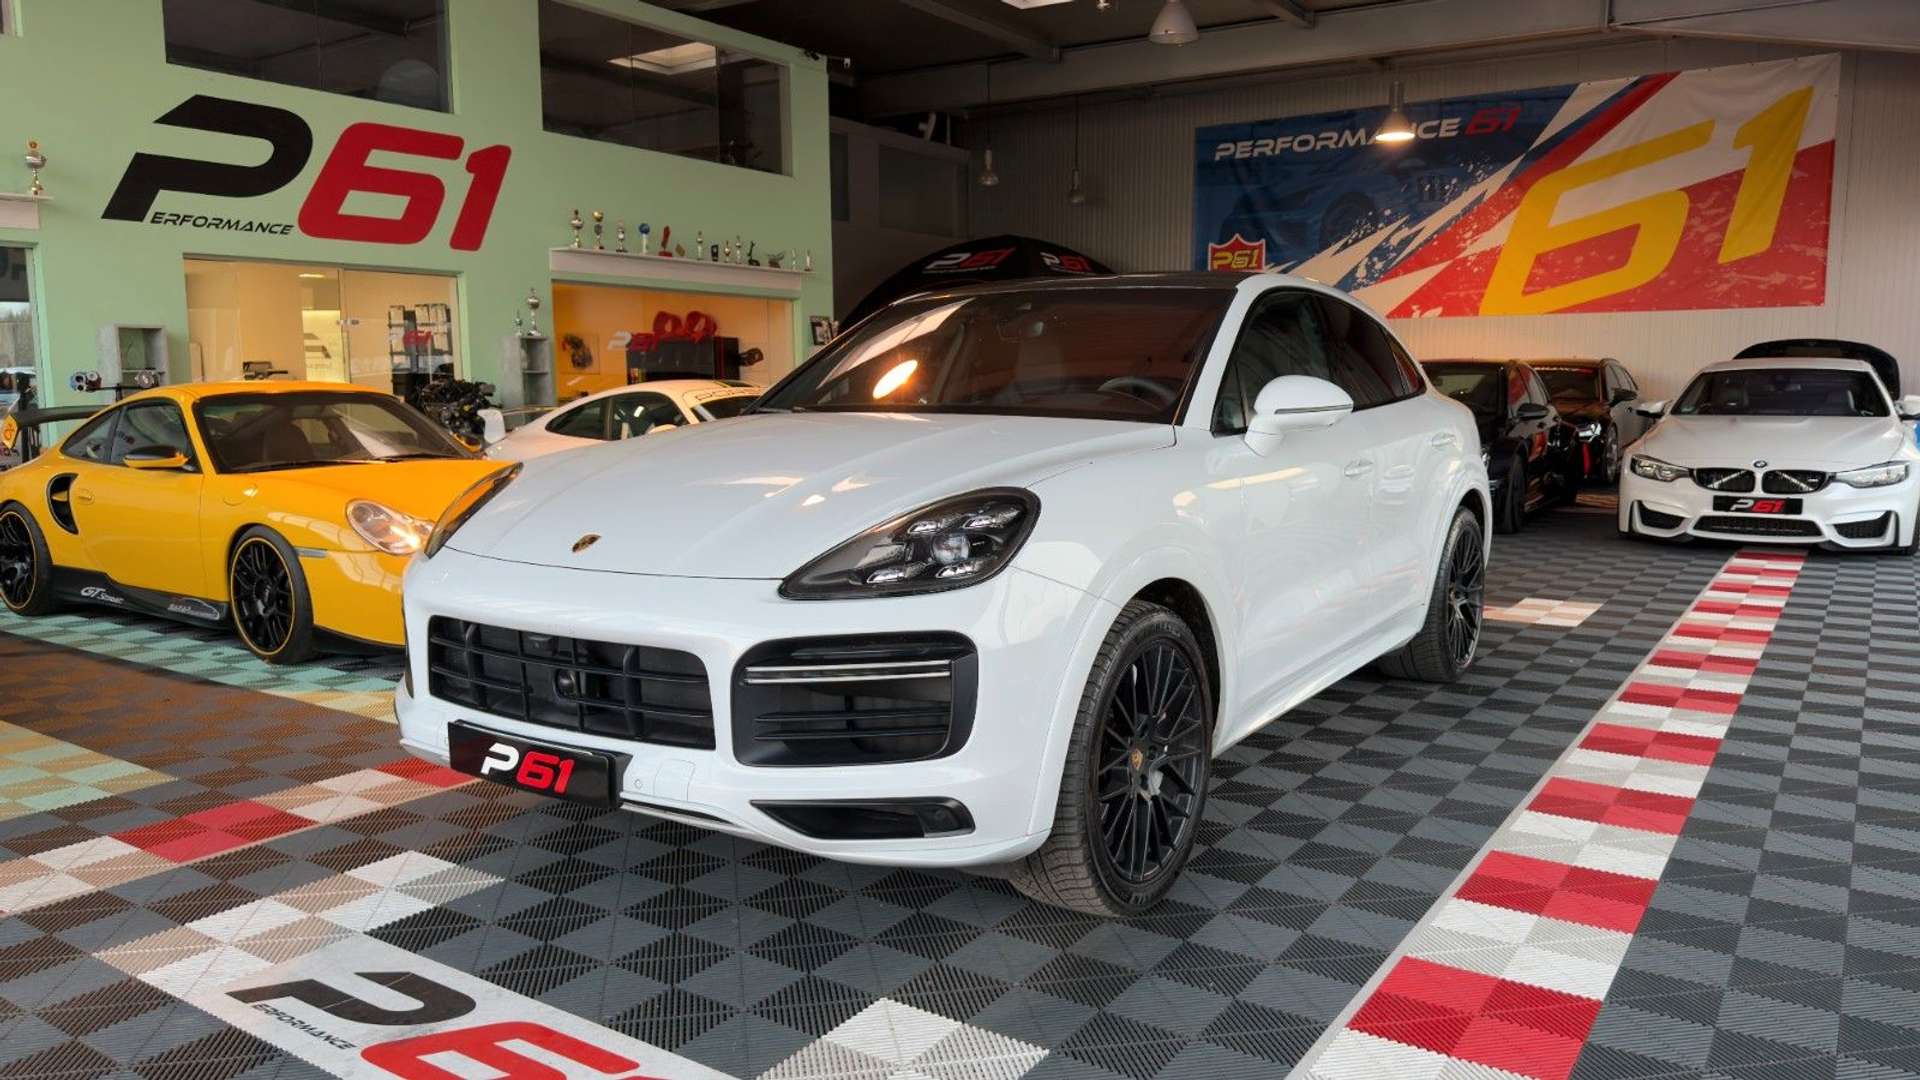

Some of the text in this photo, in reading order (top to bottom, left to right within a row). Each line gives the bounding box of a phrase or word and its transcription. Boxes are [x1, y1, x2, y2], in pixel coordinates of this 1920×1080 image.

[1215, 106, 1522, 160] PERFORMCE 61
[101, 94, 512, 252] P61
[1478, 86, 1815, 316] 61
[1213, 249, 1260, 270] P61
[1730, 499, 1784, 513] P61
[480, 742, 575, 794] P61
[225, 972, 680, 1080] P6
